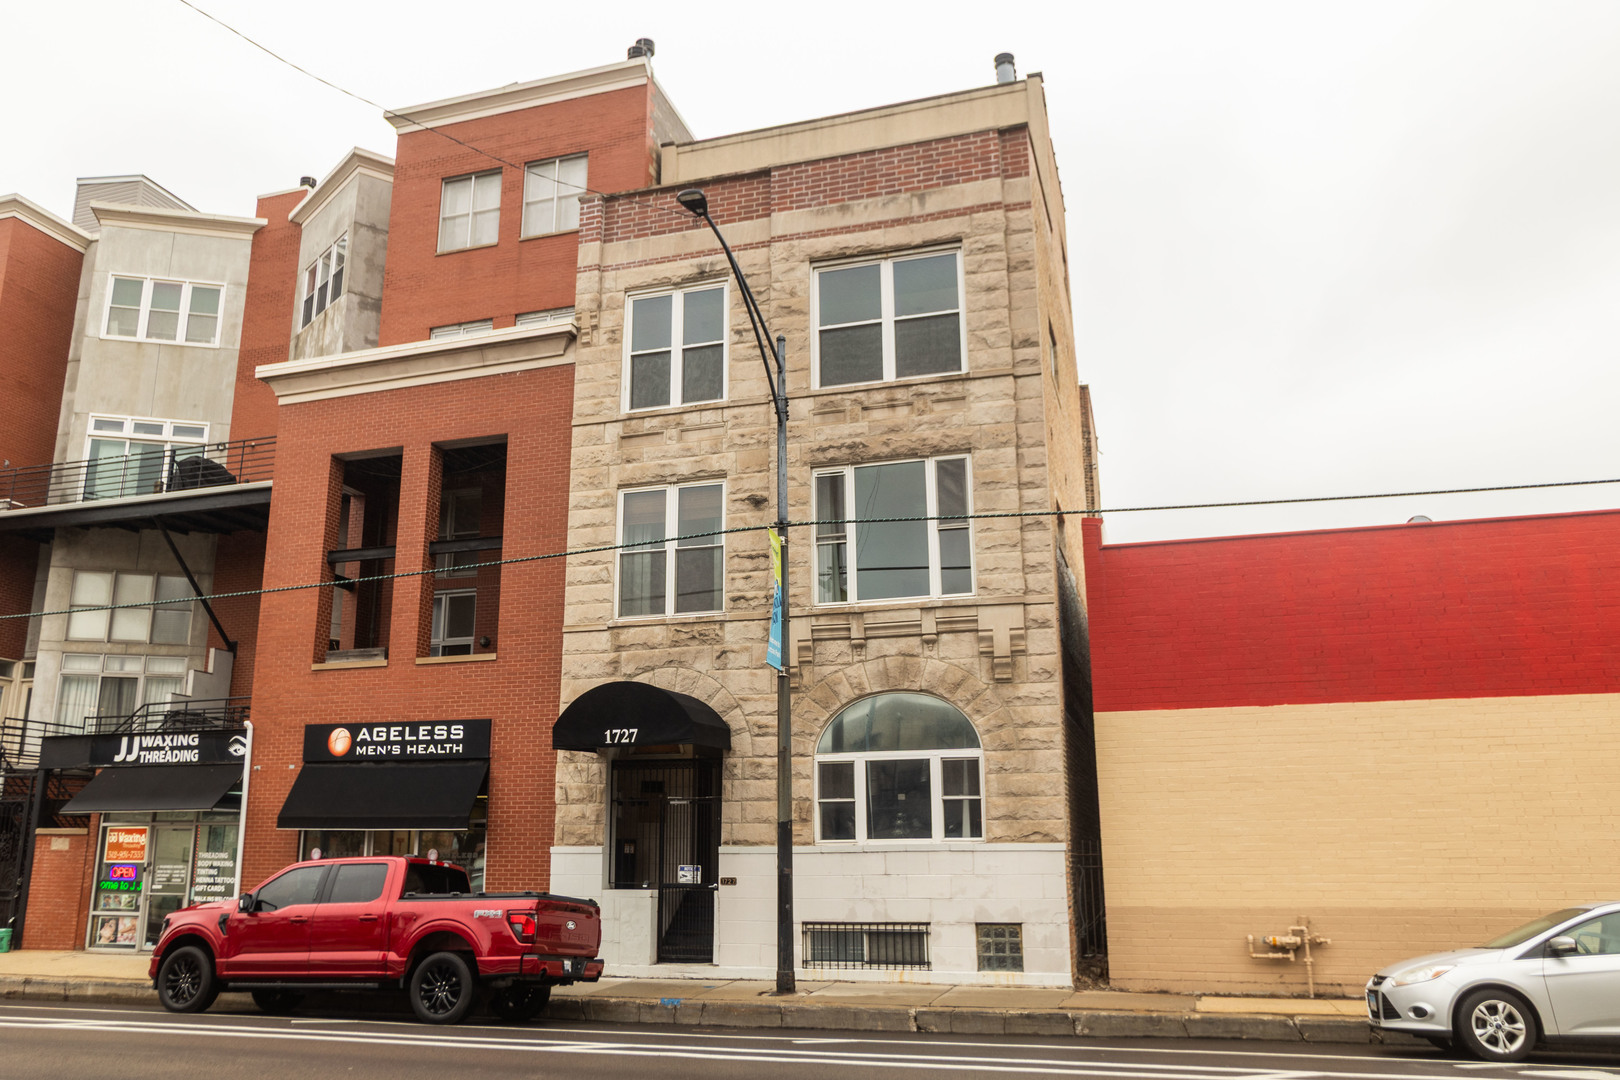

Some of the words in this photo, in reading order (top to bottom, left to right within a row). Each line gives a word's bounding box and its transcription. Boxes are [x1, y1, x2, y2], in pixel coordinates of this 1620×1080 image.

[356, 725, 464, 742] AGELESS
[604, 728, 639, 744] 1727
[113, 736, 140, 762] JJ
[141, 734, 199, 748] WAXING
[356, 745, 401, 756] MEN'S
[407, 744, 463, 755] HEALTH
[139, 749, 199, 763] THREADING
[112, 866, 135, 878] OPEN
